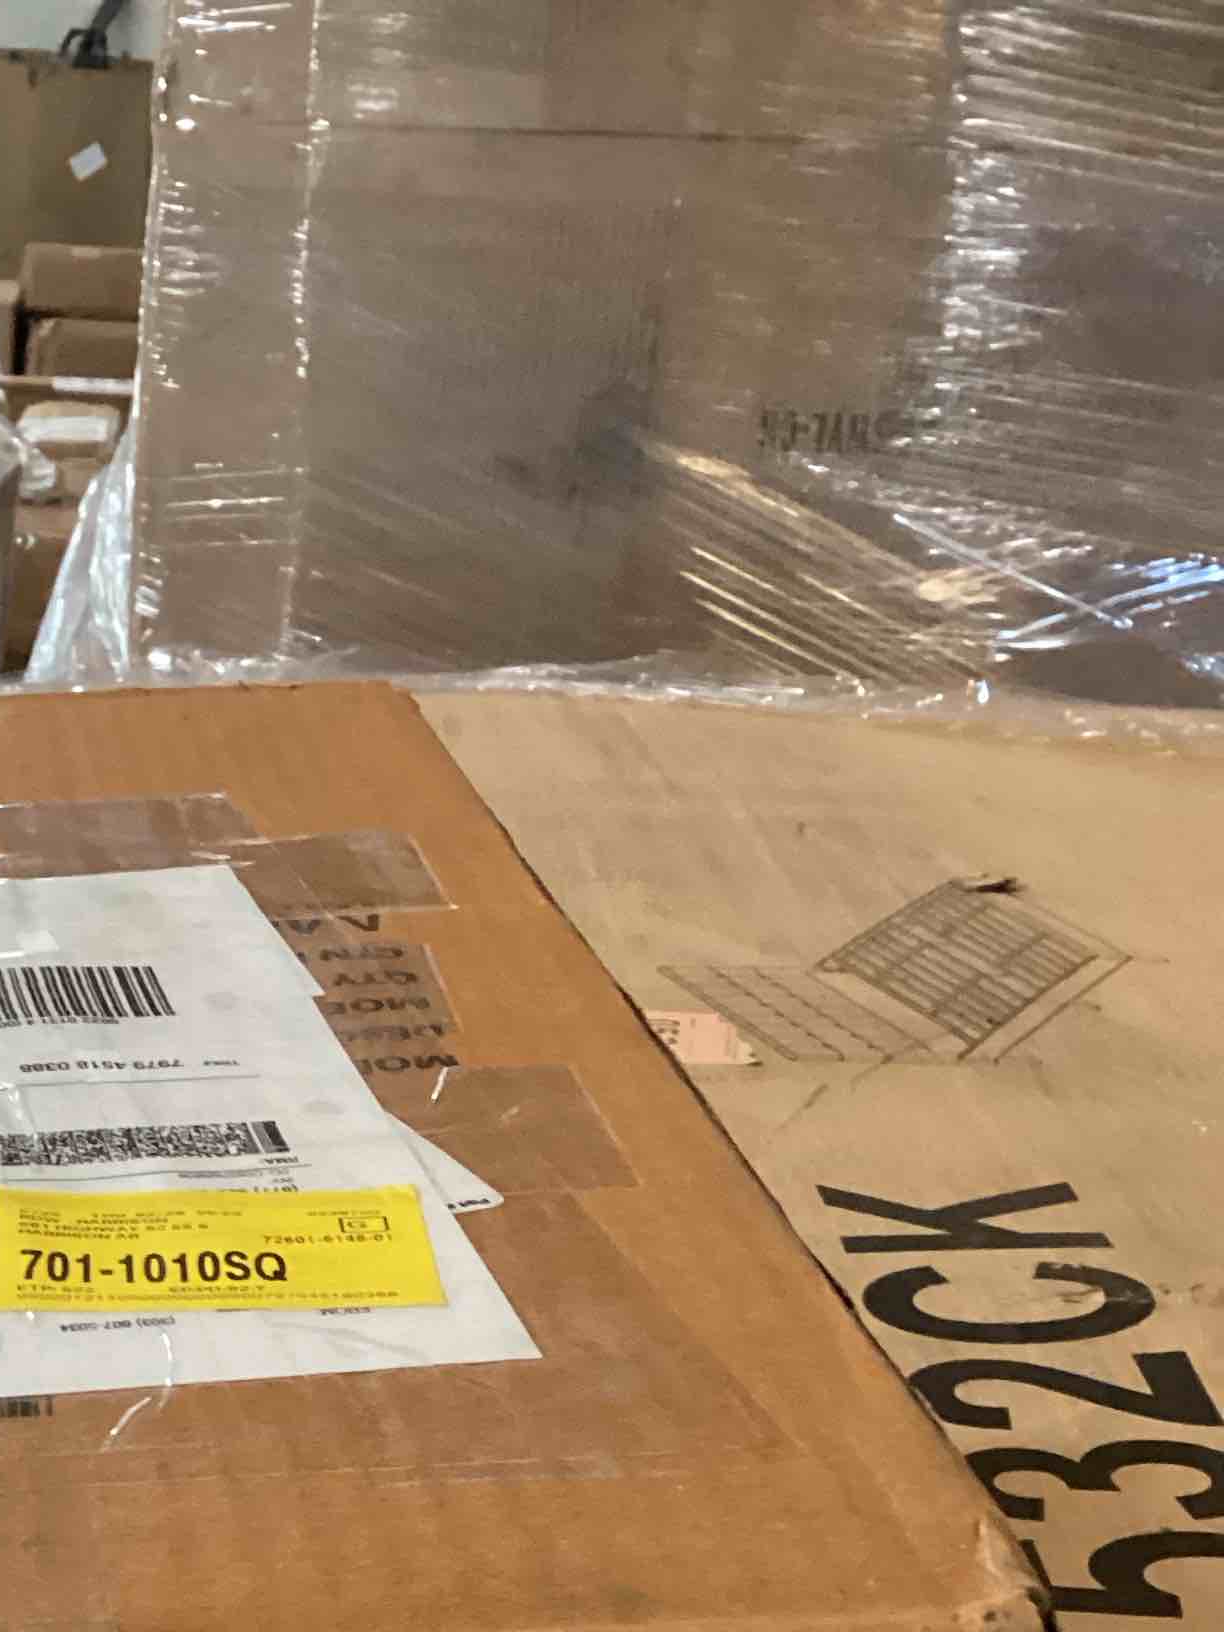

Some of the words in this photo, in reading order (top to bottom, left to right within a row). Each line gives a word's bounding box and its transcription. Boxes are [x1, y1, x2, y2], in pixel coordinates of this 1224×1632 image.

[18, 1062, 71, 1074] 0388
[75, 1060, 127, 1072] 4518
[133, 1058, 184, 1070] 7979
[19, 1248, 289, 1284] 701-1010SQ
